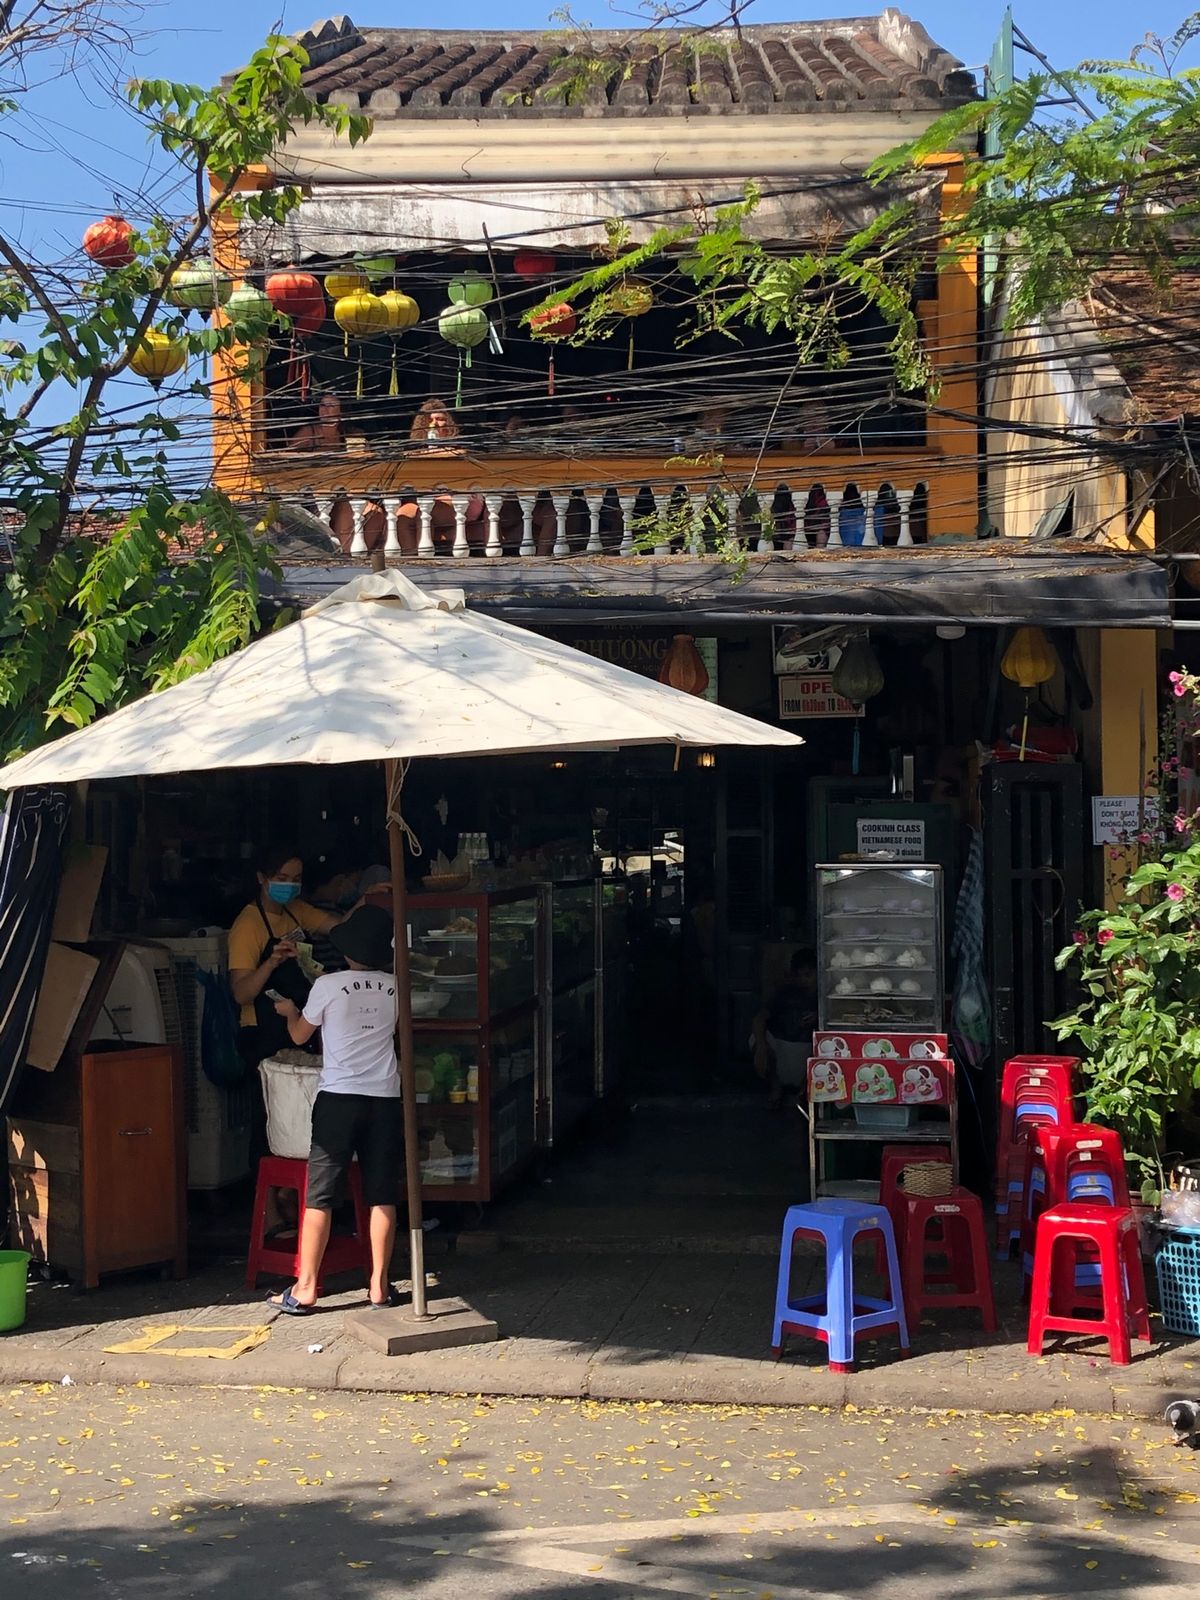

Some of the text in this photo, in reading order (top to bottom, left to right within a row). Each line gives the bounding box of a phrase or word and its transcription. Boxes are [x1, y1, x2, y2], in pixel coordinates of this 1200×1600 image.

[800, 682, 833, 695] OPE
[784, 699, 801, 712] FROM
[827, 698, 836, 711] TO
[897, 824, 921, 832] CLASS
[862, 836, 902, 844] VIETNAMESE
[341, 980, 396, 996] TOKYO
